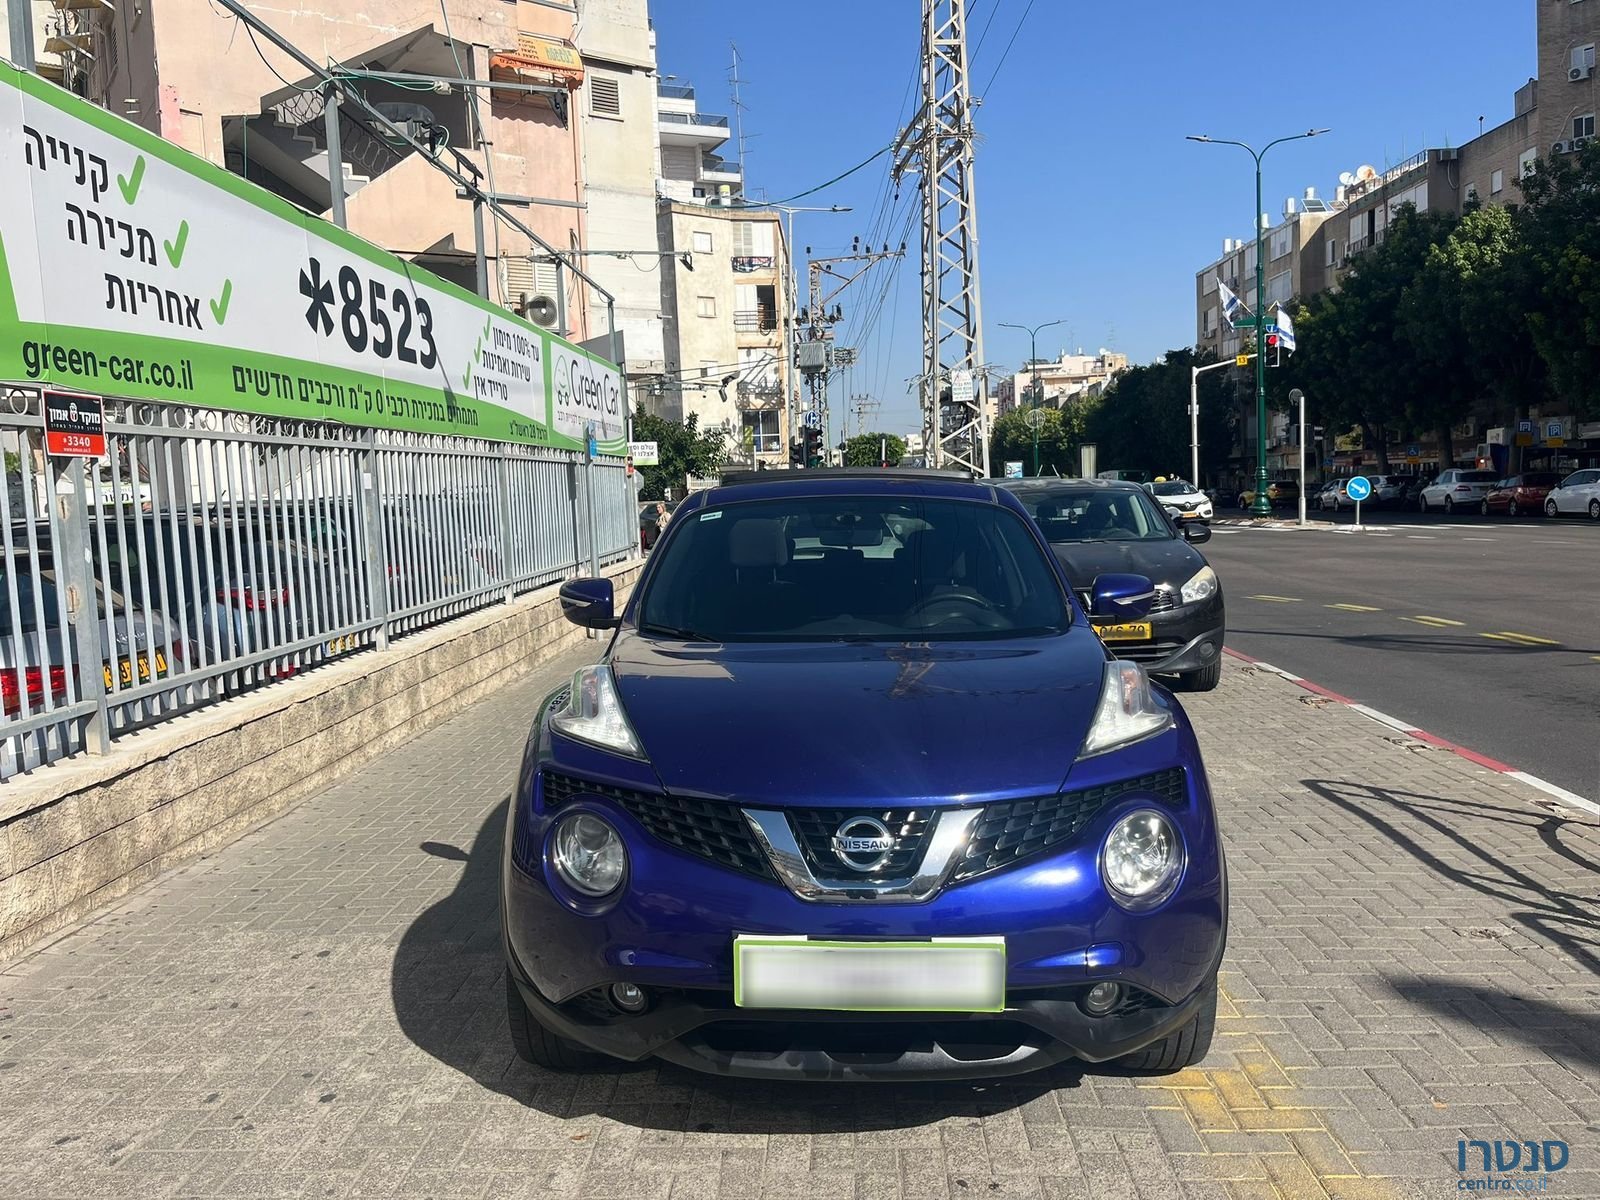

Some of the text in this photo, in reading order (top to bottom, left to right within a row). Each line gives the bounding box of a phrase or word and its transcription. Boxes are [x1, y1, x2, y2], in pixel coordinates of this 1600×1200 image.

[23, 124, 108, 202] קנייה
[65, 202, 157, 267] מכירה
[105, 273, 203, 330] אחריות
[22, 341, 194, 390] green-car.co.il
[232, 365, 294, 400] חדשים
[298, 377, 345, 408] ורכבים
[474, 375, 486, 400] אין
[571, 360, 619, 416] Green Car
[49, 408, 101, 426] מוקד אמון
[386, 395, 410, 418] רכבי
[411, 399, 445, 422] במכירת
[838, 840, 889, 849] NISSAN
